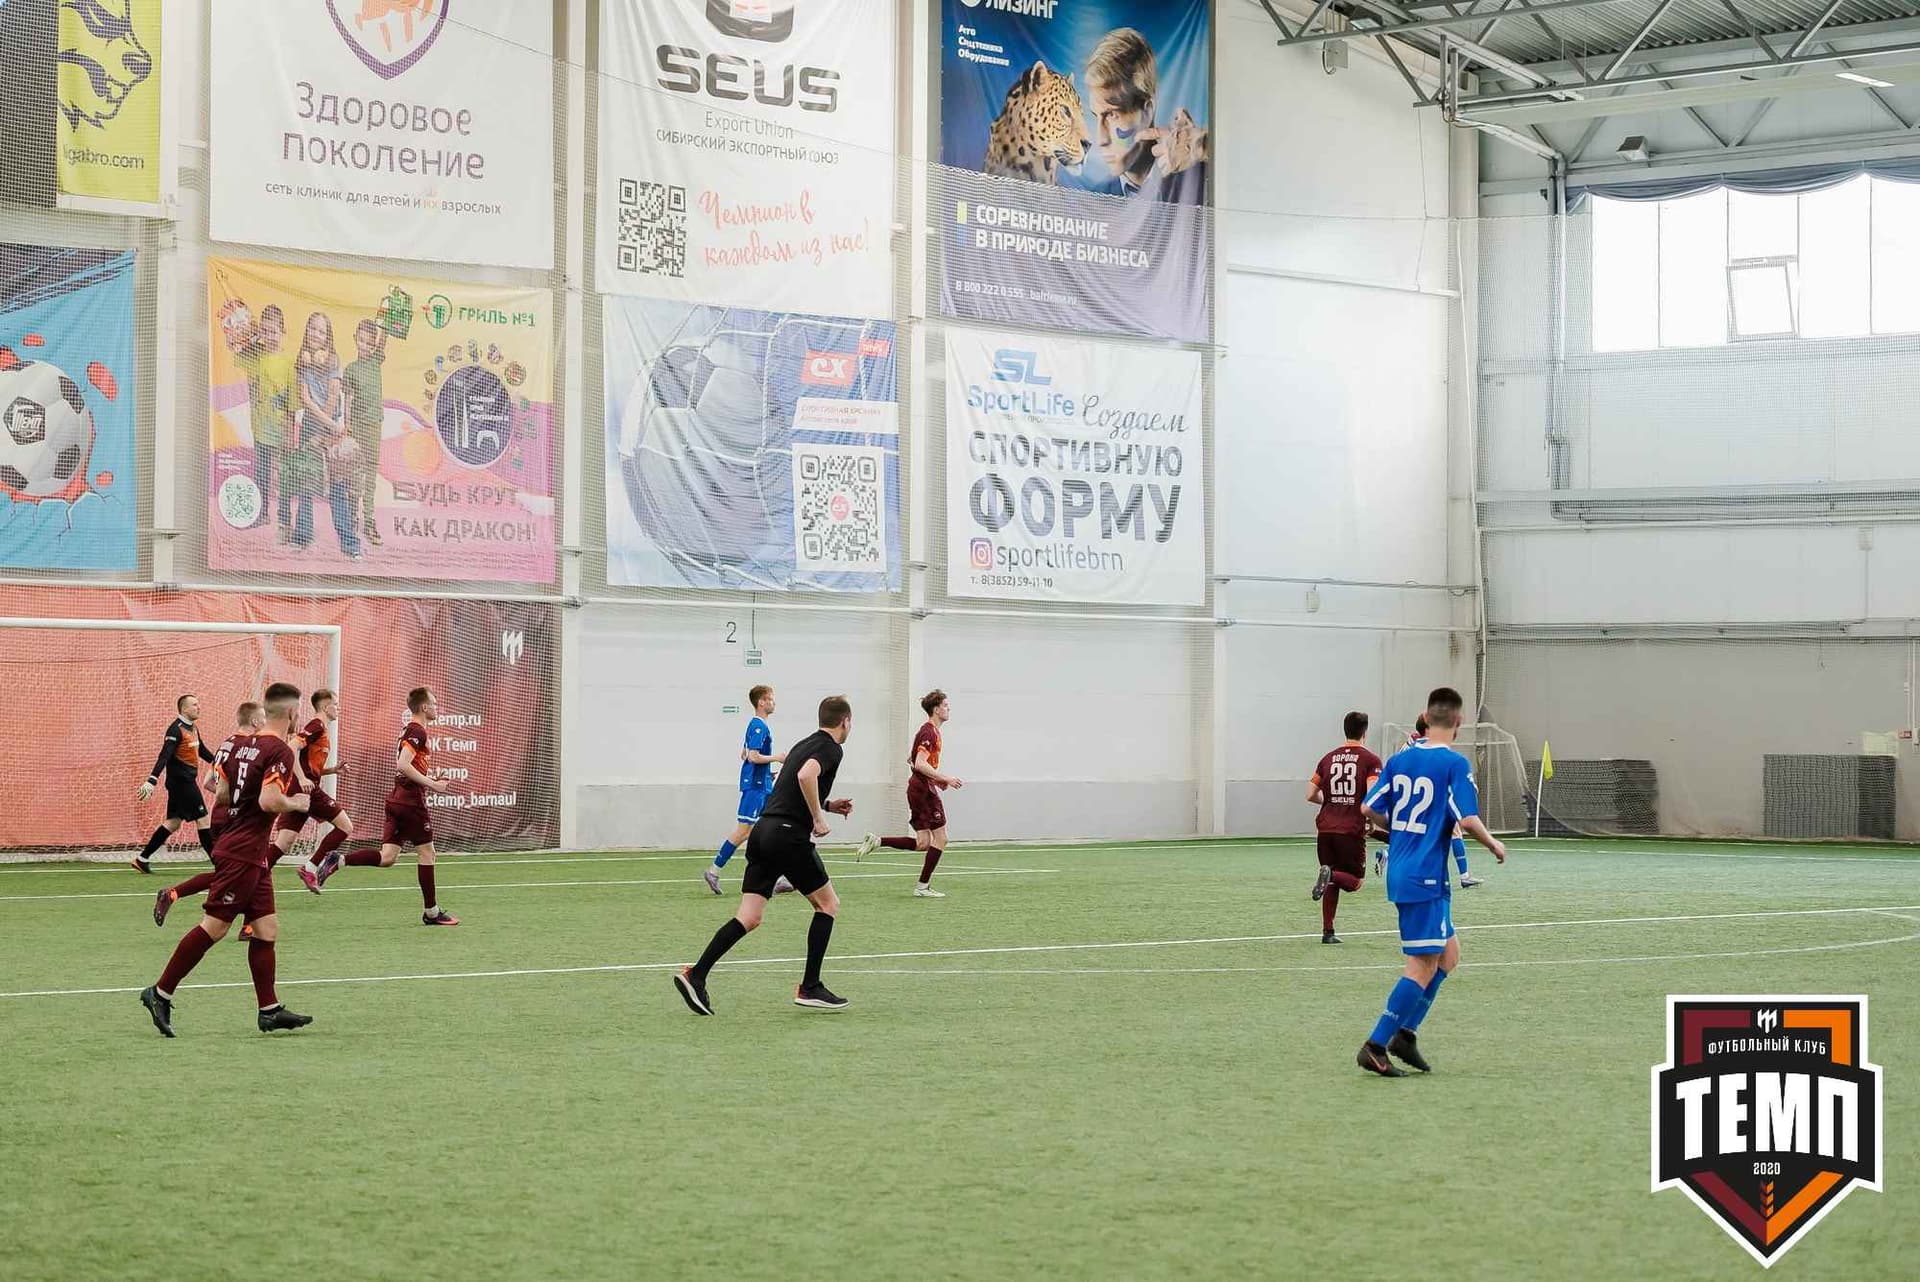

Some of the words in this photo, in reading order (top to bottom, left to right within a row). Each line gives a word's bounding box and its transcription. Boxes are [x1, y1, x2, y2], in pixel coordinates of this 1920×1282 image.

[655, 44, 841, 112] SEUS
[295, 80, 473, 137] Здоровое
[705, 111, 751, 134] Export
[754, 119, 794, 139] Union
[282, 131, 485, 180] поколение
[656, 128, 727, 150] СИБИРСКИЙ
[729, 139, 807, 161] ЭКСПОРТНЫЙ
[809, 149, 840, 164] СОЮЗ
[265, 181, 293, 195] сеть
[296, 184, 343, 201] клиник
[345, 190, 370, 204] для
[372, 193, 410, 208] детей
[412, 199, 422, 208] и
[441, 201, 501, 216] взрослых
[699, 190, 796, 230] Чемпион
[799, 190, 815, 225] в
[976, 204, 1108, 240] СОРЕВНОВАНИЕ
[704, 230, 795, 266] каждом
[975, 229, 988, 248] В
[991, 232, 1073, 262] ПРИРОДЕ
[1076, 243, 1150, 269] БИЗНЕСА
[459, 306, 508, 325] ГРИЛЬ
[512, 312, 536, 327] №1
[967, 385, 1076, 417] SportLife
[1082, 394, 1189, 440] Создаем
[969, 431, 1183, 478] СПОРТИВНУЮ
[393, 481, 461, 508] БУДЬ
[969, 473, 1182, 543] ФОРМУ
[393, 516, 438, 538] КАК
[443, 519, 537, 544] ДРАКОН!
[996, 543, 1125, 571] sportlifebrn
[726, 621, 737, 643] 2
[444, 736, 478, 752] Темп
[1329, 762, 1358, 796] 23
[1391, 774, 1434, 835] 22
